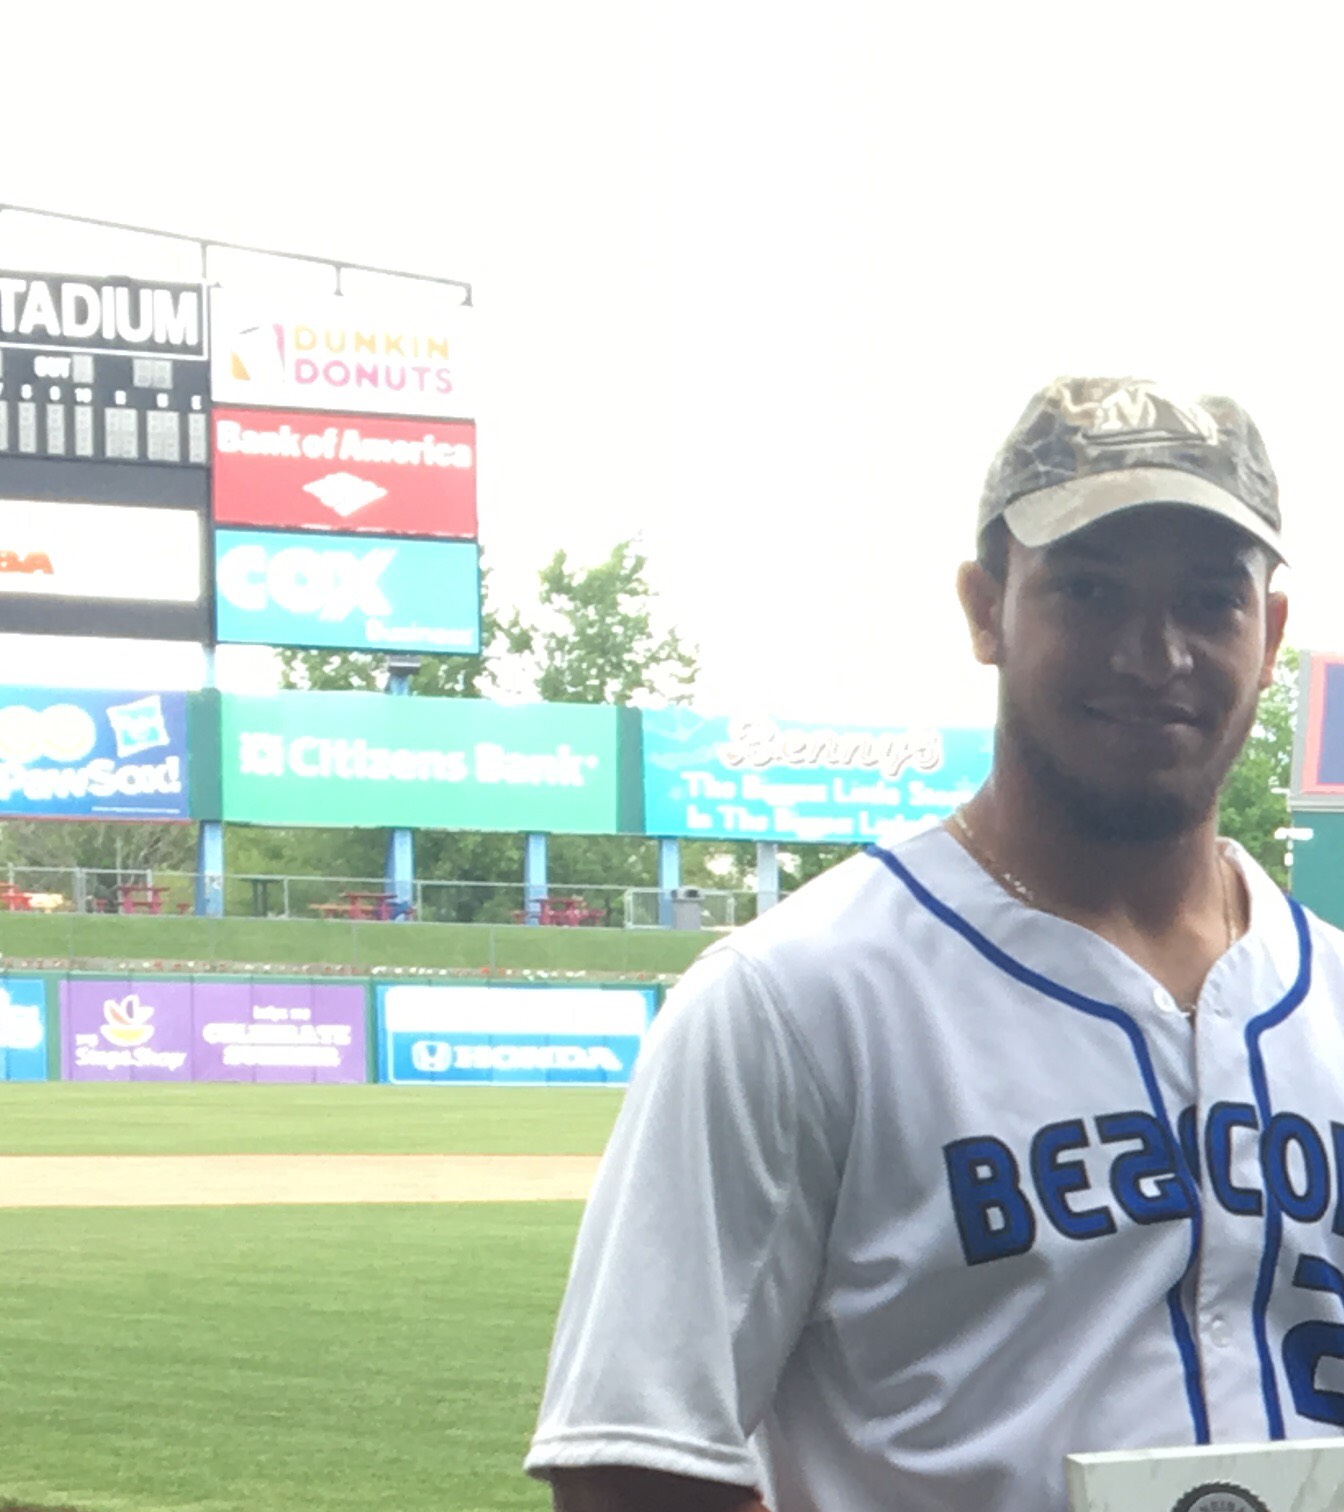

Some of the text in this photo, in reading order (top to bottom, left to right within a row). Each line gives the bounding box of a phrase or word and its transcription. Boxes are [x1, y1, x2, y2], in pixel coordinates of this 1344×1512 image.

[293, 325, 450, 360] DUNKIN
[294, 357, 454, 394] DONUTS
[216, 418, 473, 469] Bank of America
[288, 735, 585, 788] Citizens Bank
[453, 1044, 623, 1072] HONDA
